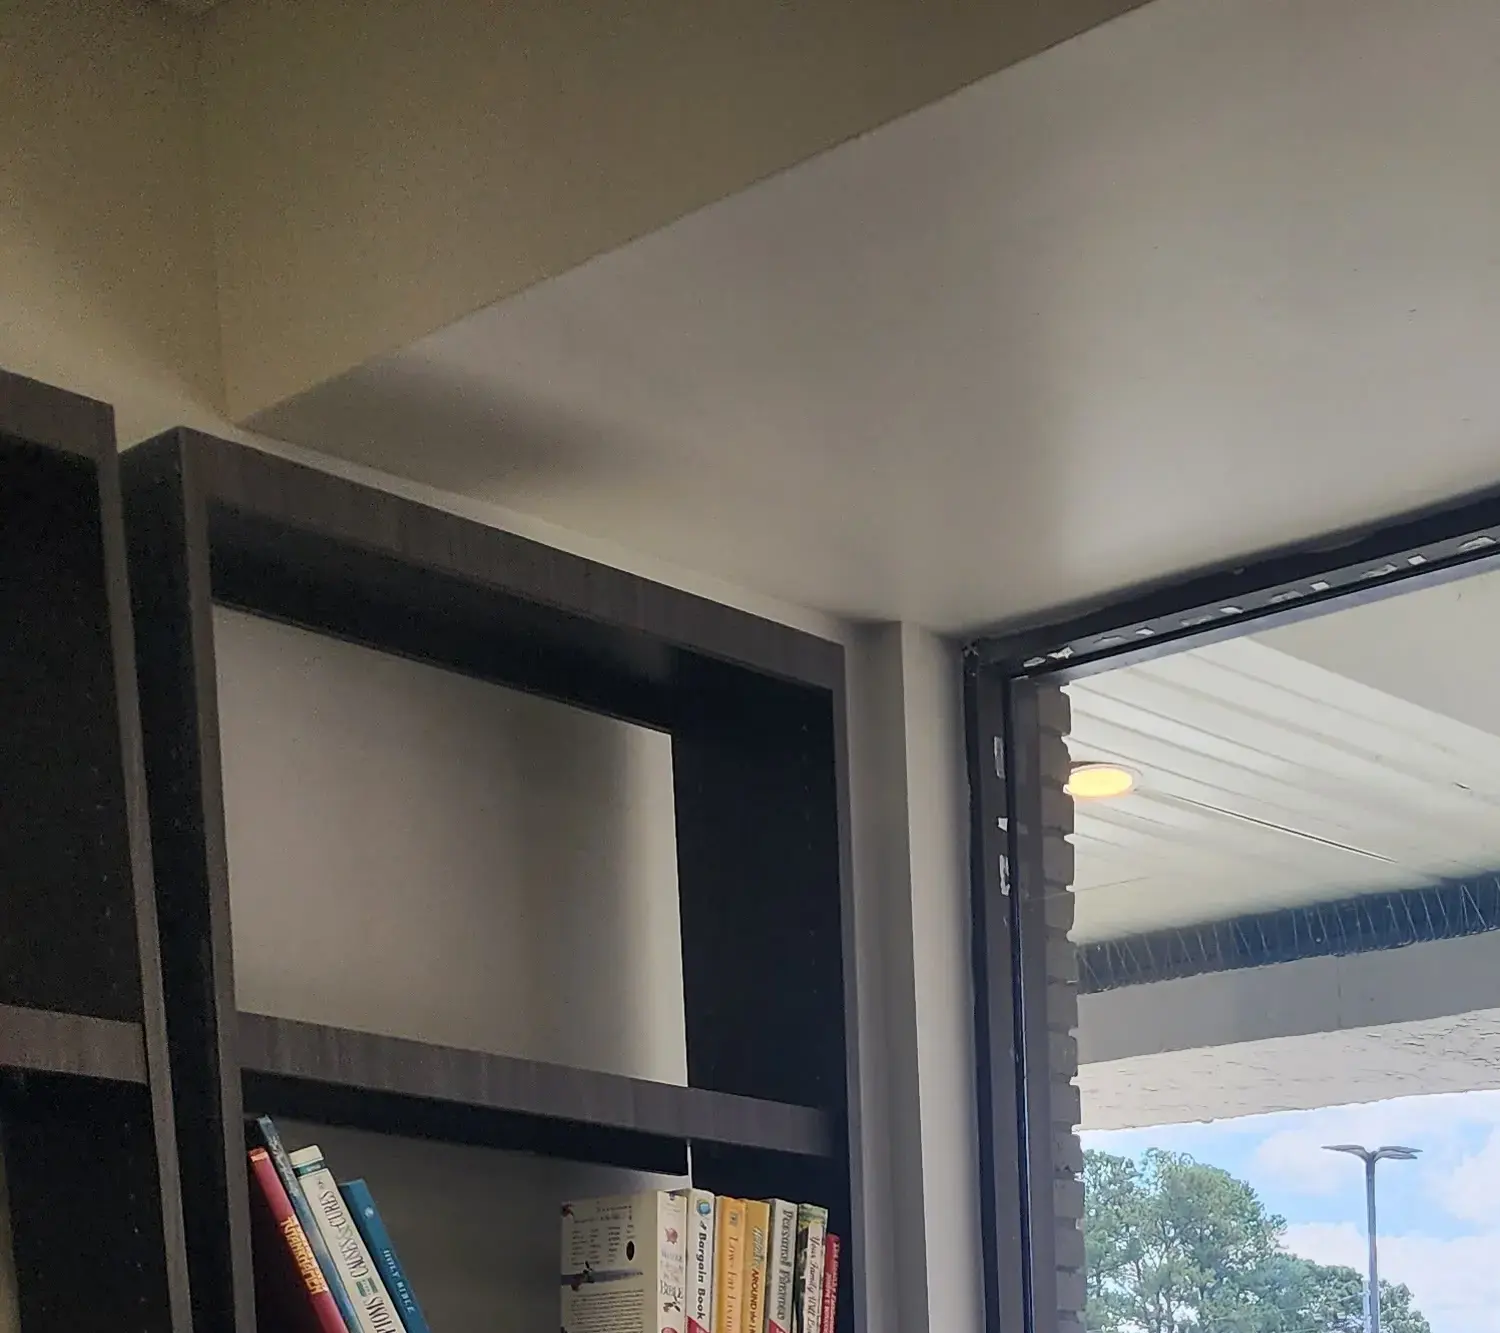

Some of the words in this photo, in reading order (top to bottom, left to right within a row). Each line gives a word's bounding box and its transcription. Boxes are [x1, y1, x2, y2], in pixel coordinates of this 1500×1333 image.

[319, 1189, 346, 1228] CURES
[781, 1210, 794, 1268] Personal
[810, 1236, 820, 1263] Your
[340, 1237, 370, 1279] CAUSES
[697, 1232, 708, 1284] Bargain
[751, 1269, 760, 1308] AROUND
[807, 1262, 819, 1292] Family
[397, 1281, 416, 1313] BIBLE
[696, 1286, 706, 1320] Book
[807, 1292, 818, 1316] Will
